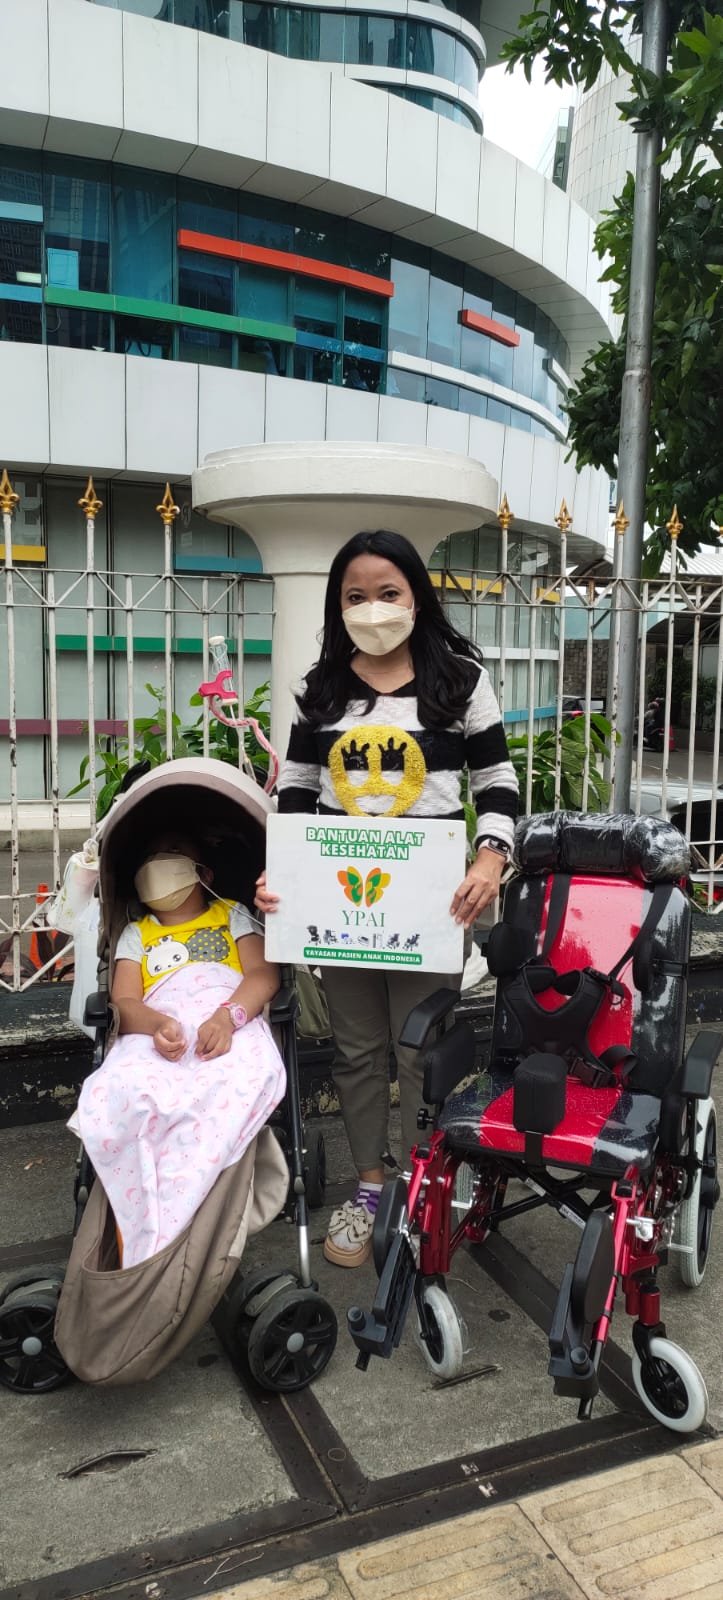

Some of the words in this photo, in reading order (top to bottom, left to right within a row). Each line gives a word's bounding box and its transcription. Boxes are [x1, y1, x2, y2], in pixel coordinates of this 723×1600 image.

[307, 827, 381, 844] BANTUAN
[385, 830, 425, 846] ALAT
[321, 842, 409, 860] KESEHATAN
[342, 909, 386, 928] YPAI
[305, 949, 338, 958] YAYASAN
[338, 951, 362, 959] PASIEN
[363, 952, 382, 961] ANAK
[383, 953, 421, 963] INDONESIA
